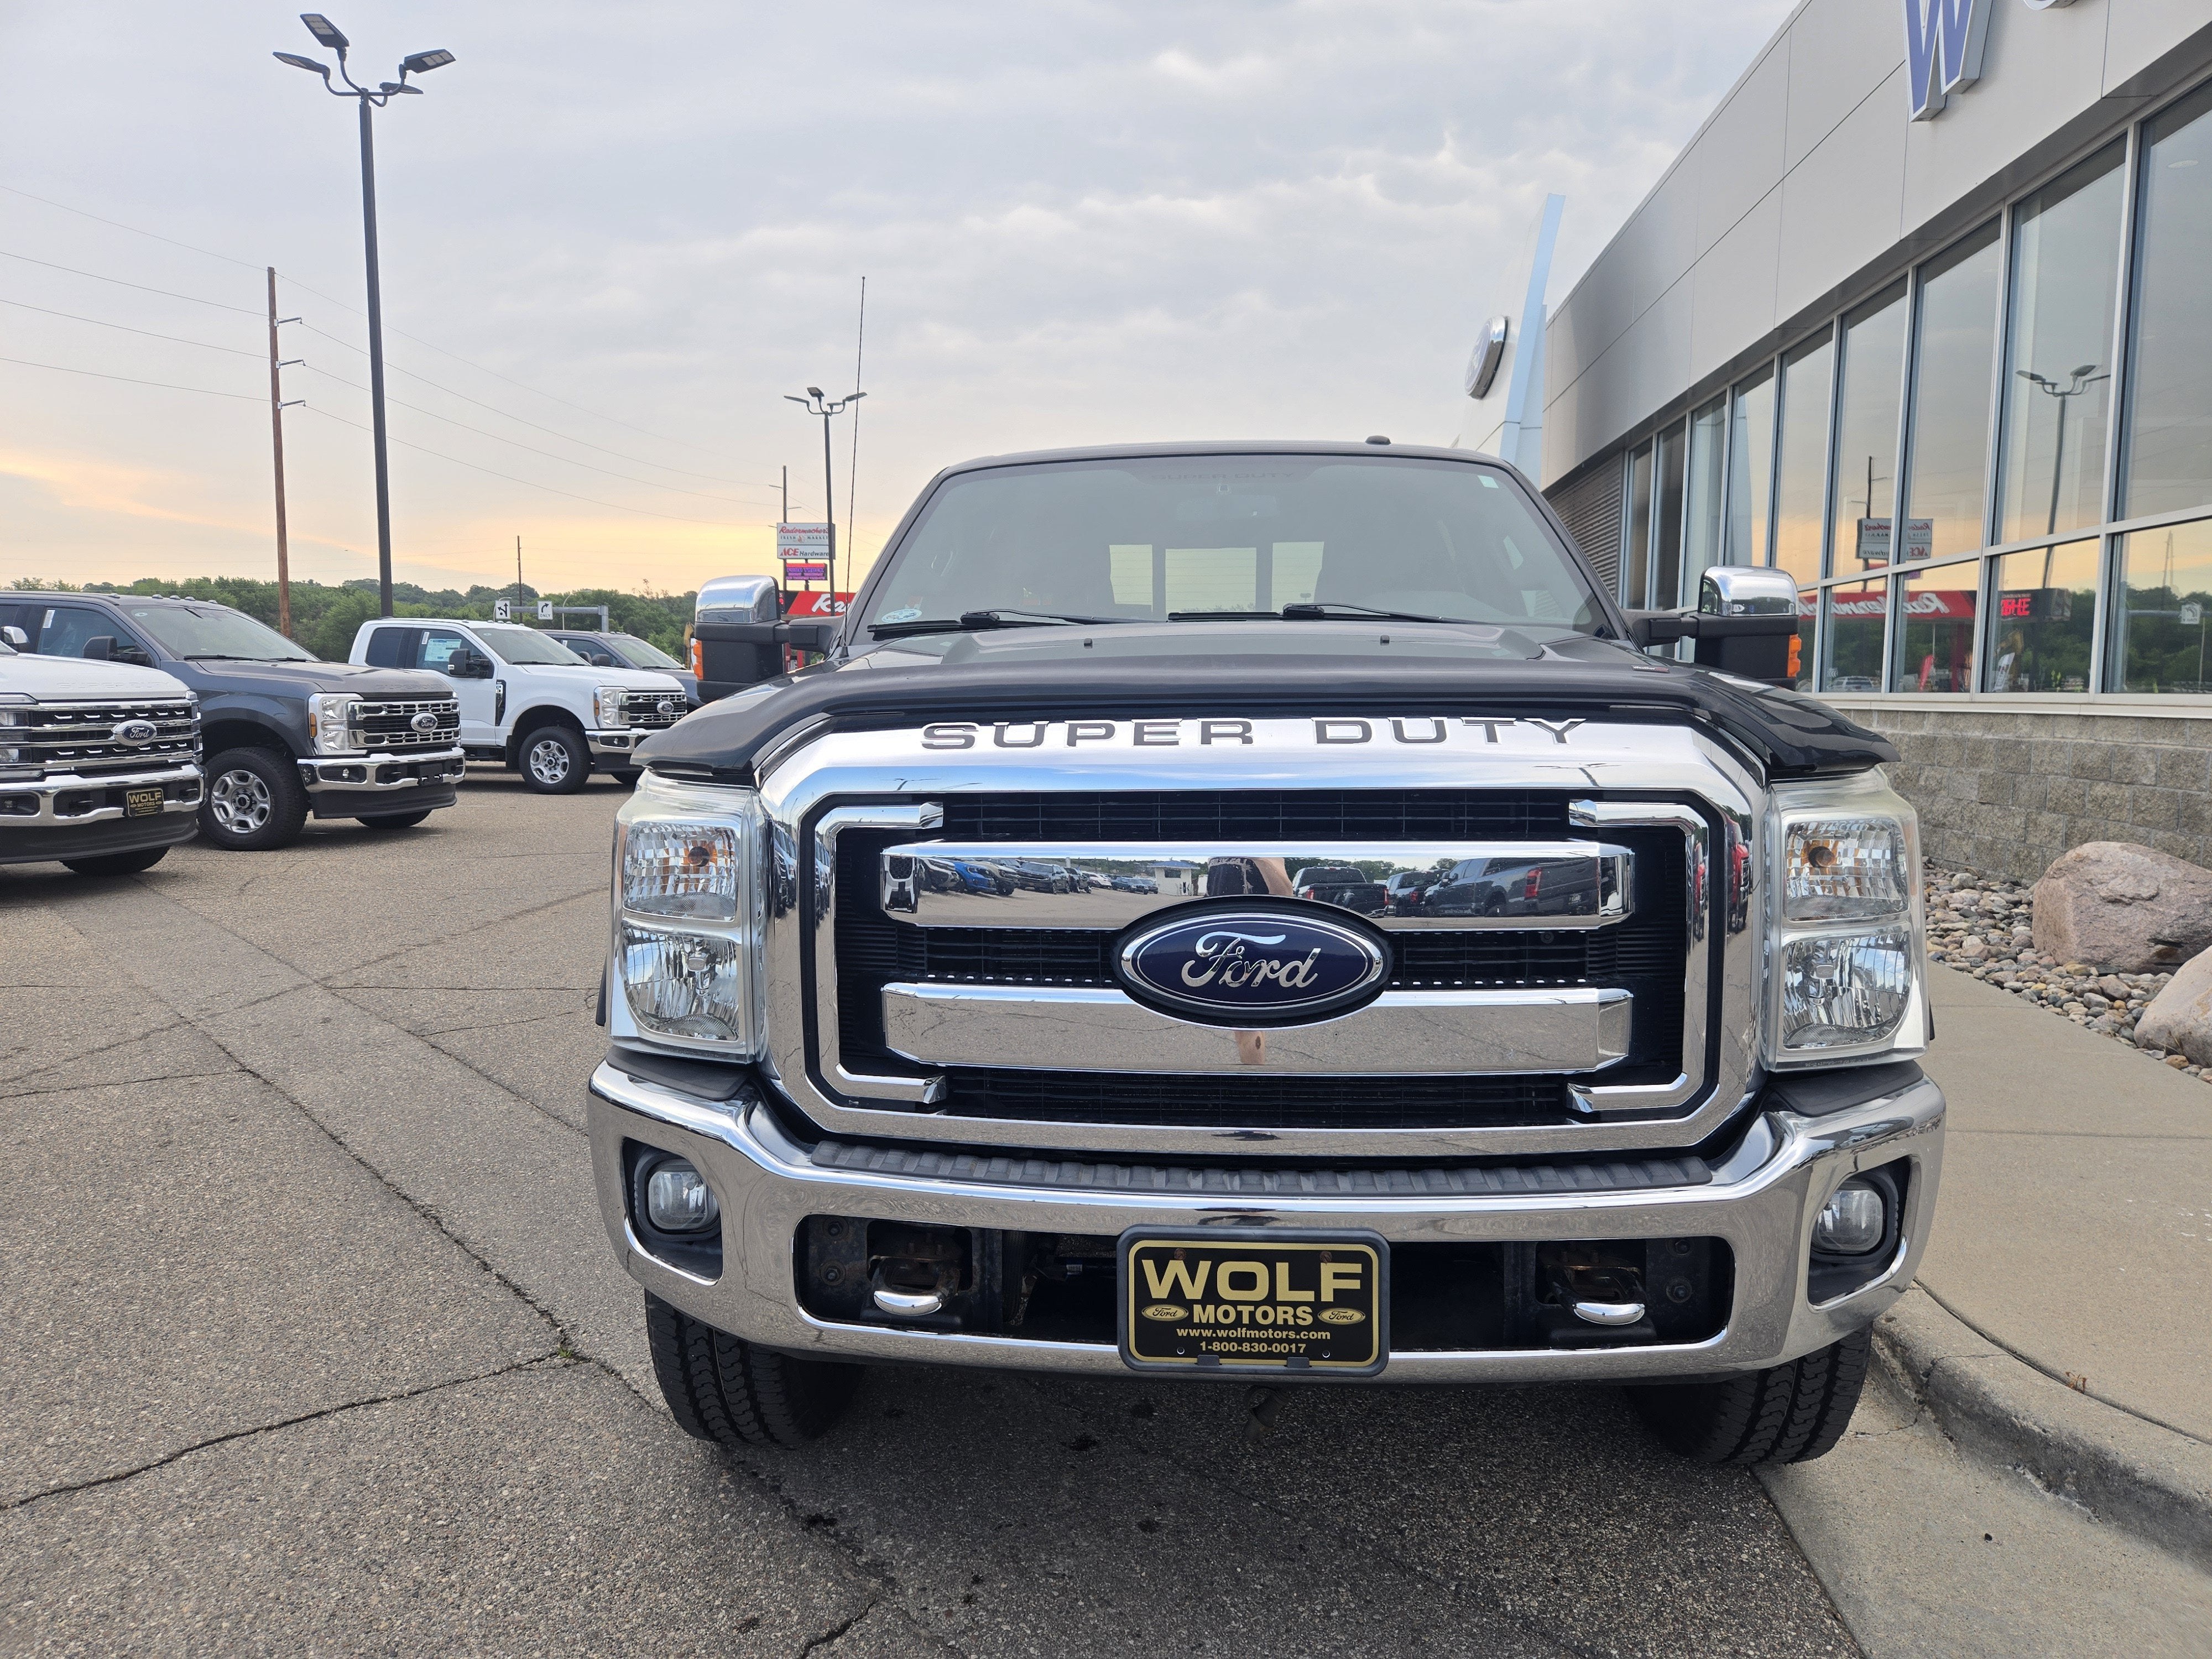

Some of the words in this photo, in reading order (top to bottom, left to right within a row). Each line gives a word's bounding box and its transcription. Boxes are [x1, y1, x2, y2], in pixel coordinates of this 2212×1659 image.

[780, 547, 799, 556] ACE
[129, 727, 149, 738] Ford
[921, 719, 1255, 750] SUPER
[1311, 717, 1587, 745] DUTY
[129, 792, 161, 804] WOLF
[1181, 931, 1321, 988] Ford
[1142, 1259, 1362, 1302] WOLF
[1152, 1307, 1178, 1317] Ford
[1193, 1304, 1313, 1326] MOTORS
[1329, 1311, 1354, 1320] Ford
[1177, 1328, 1331, 1339] www.wolfmotors.com
[1200, 1342, 1306, 1353] 1-800-830-0017
